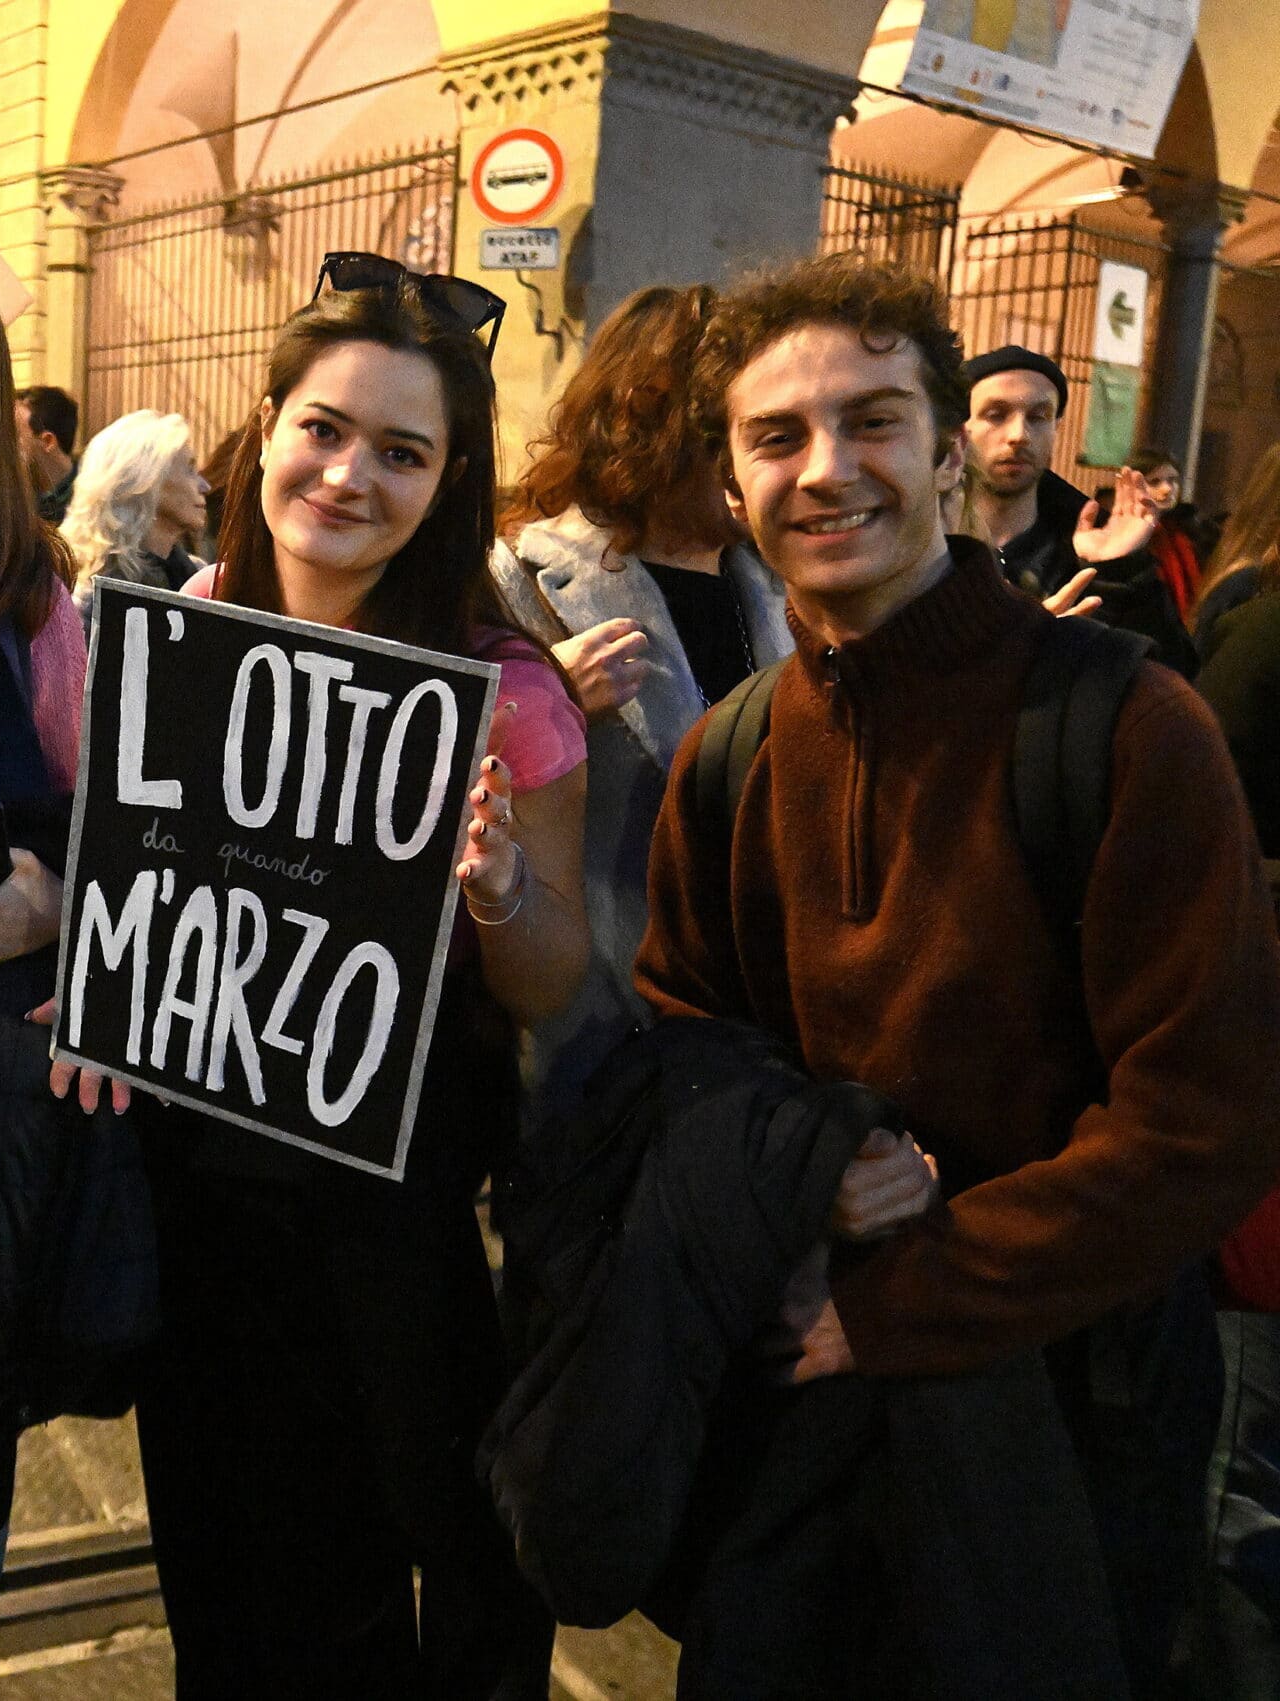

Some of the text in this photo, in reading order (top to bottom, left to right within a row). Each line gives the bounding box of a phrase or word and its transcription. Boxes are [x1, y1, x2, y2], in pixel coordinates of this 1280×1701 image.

[141, 817, 332, 887] da quando
[223, 643, 458, 862] OTTO
[69, 868, 400, 1128] M'ARZO
